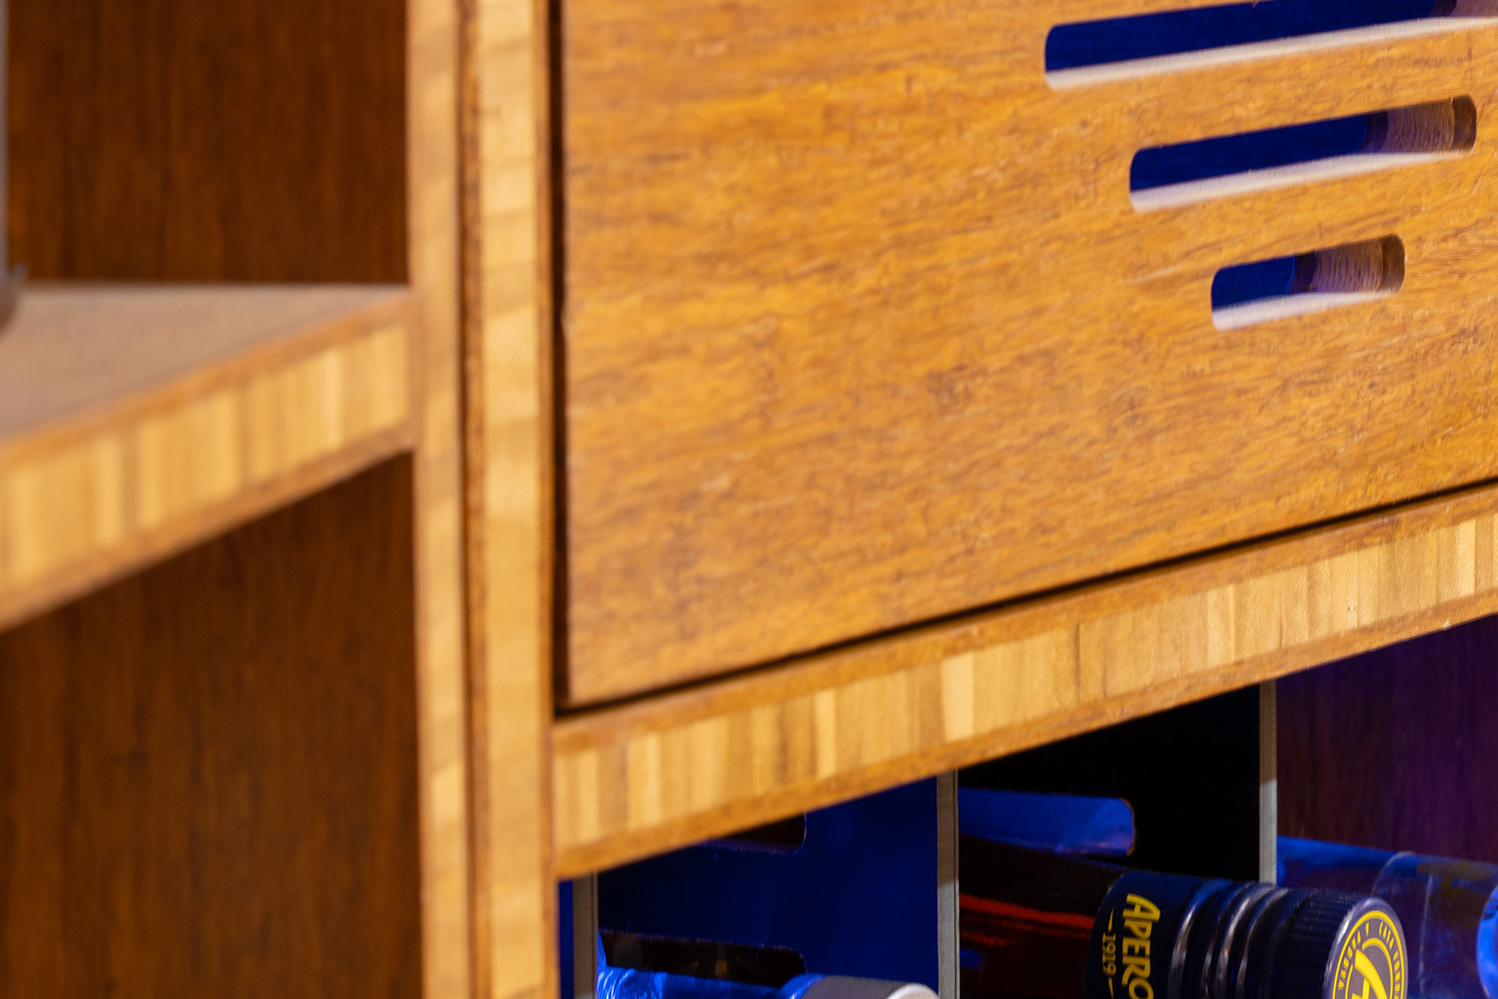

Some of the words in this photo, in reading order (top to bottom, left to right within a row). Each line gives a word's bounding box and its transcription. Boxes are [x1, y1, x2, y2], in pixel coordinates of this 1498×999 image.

[1102, 932, 1117, 976] 1919
[1122, 893, 1161, 999] APERO
[1379, 921, 1395, 951] CASA
